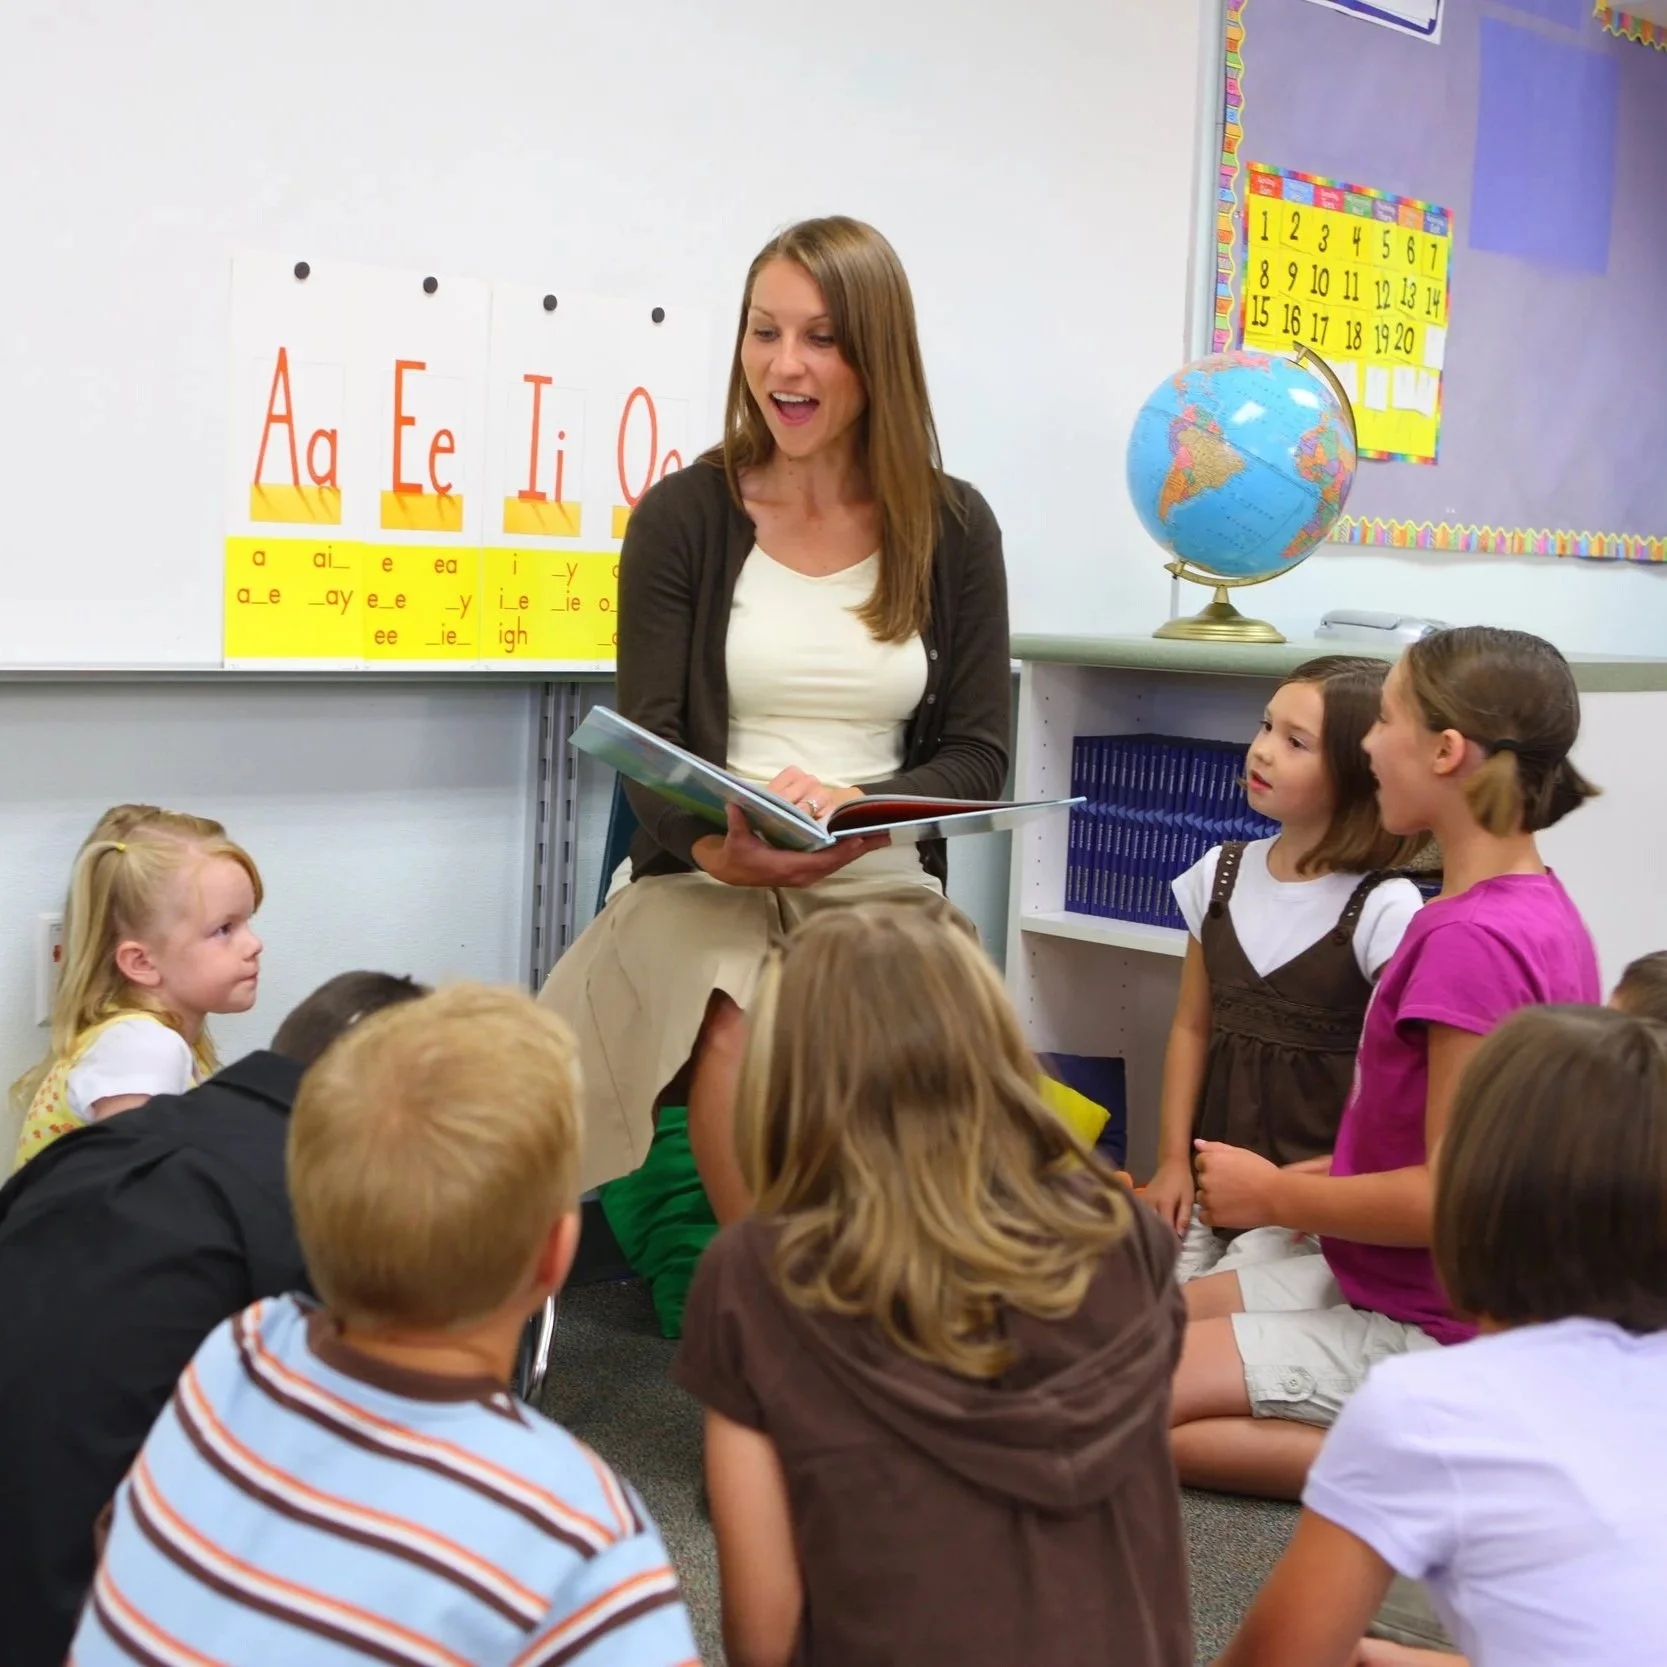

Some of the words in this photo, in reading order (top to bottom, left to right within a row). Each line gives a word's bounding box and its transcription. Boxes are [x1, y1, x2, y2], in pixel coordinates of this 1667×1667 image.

[1261, 210, 1269, 241] 1
[1290, 210, 1301, 241] 2
[1318, 224, 1330, 253] 3
[1352, 226, 1362, 257] 4
[1382, 229, 1391, 260] 5
[1406, 236, 1415, 265] 6
[1429, 244, 1438, 271] 7
[1259, 259, 1270, 290] 8
[1287, 261, 1299, 292] 9
[1310, 264, 1330, 297] 10
[1343, 270, 1360, 302] 11
[1375, 280, 1392, 310] 12
[1400, 277, 1417, 310] 13
[1425, 287, 1441, 318] 14
[1251, 294, 1271, 328] 15
[1282, 303, 1302, 336] 16
[1310, 313, 1330, 346] 17
[1345, 321, 1362, 351] 18
[1374, 323, 1390, 355] 19
[1394, 322, 1415, 355] 20
[253, 346, 339, 489] Aa
[392, 359, 456, 499] Ee
[517, 374, 566, 504] Ii
[252, 550, 266, 567] a
[381, 557, 393, 573] e
[434, 558, 458, 574] ea
[513, 553, 518, 576] i
[374, 629, 398, 645] ee
[499, 615, 528, 654] igh
